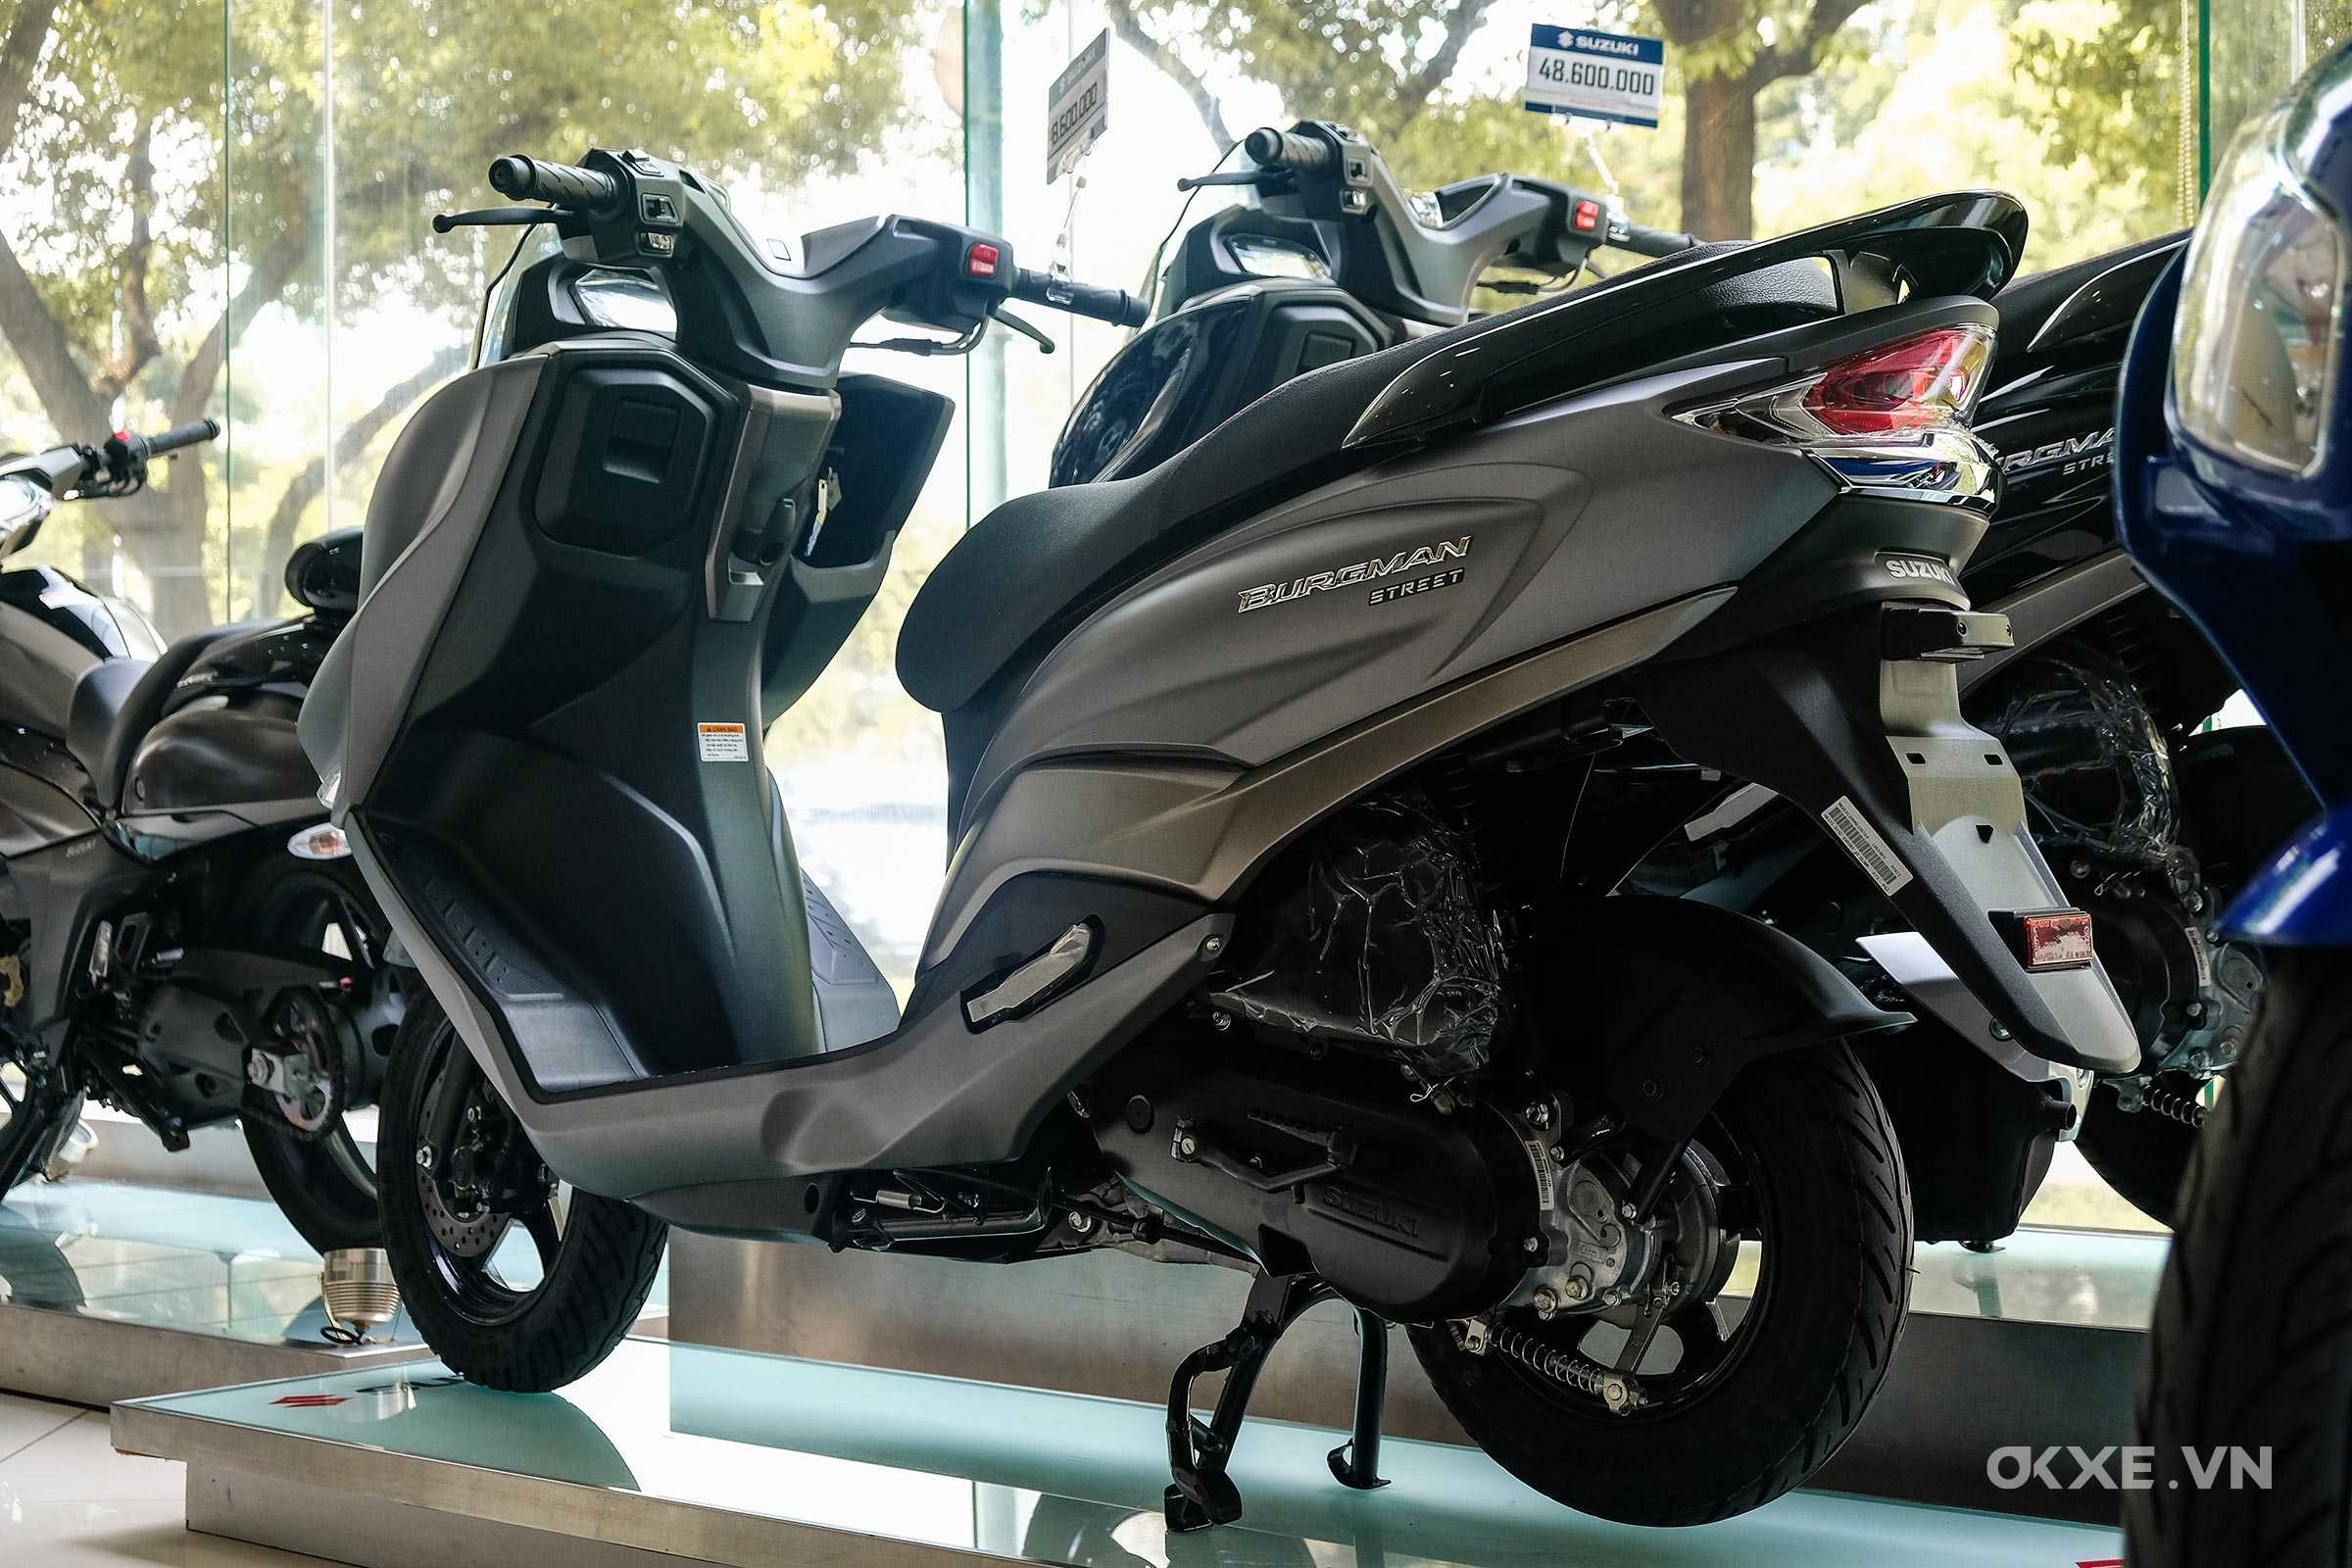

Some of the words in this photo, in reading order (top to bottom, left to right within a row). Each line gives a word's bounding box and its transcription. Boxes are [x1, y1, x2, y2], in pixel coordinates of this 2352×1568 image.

[1576, 35, 1639, 56] SUZUKI
[1539, 58, 1654, 95] 48.600.000
[1239, 536, 1471, 613] BURGMAN
[1370, 568, 1463, 605] STREET
[1886, 560, 1956, 586] SUZUKI
